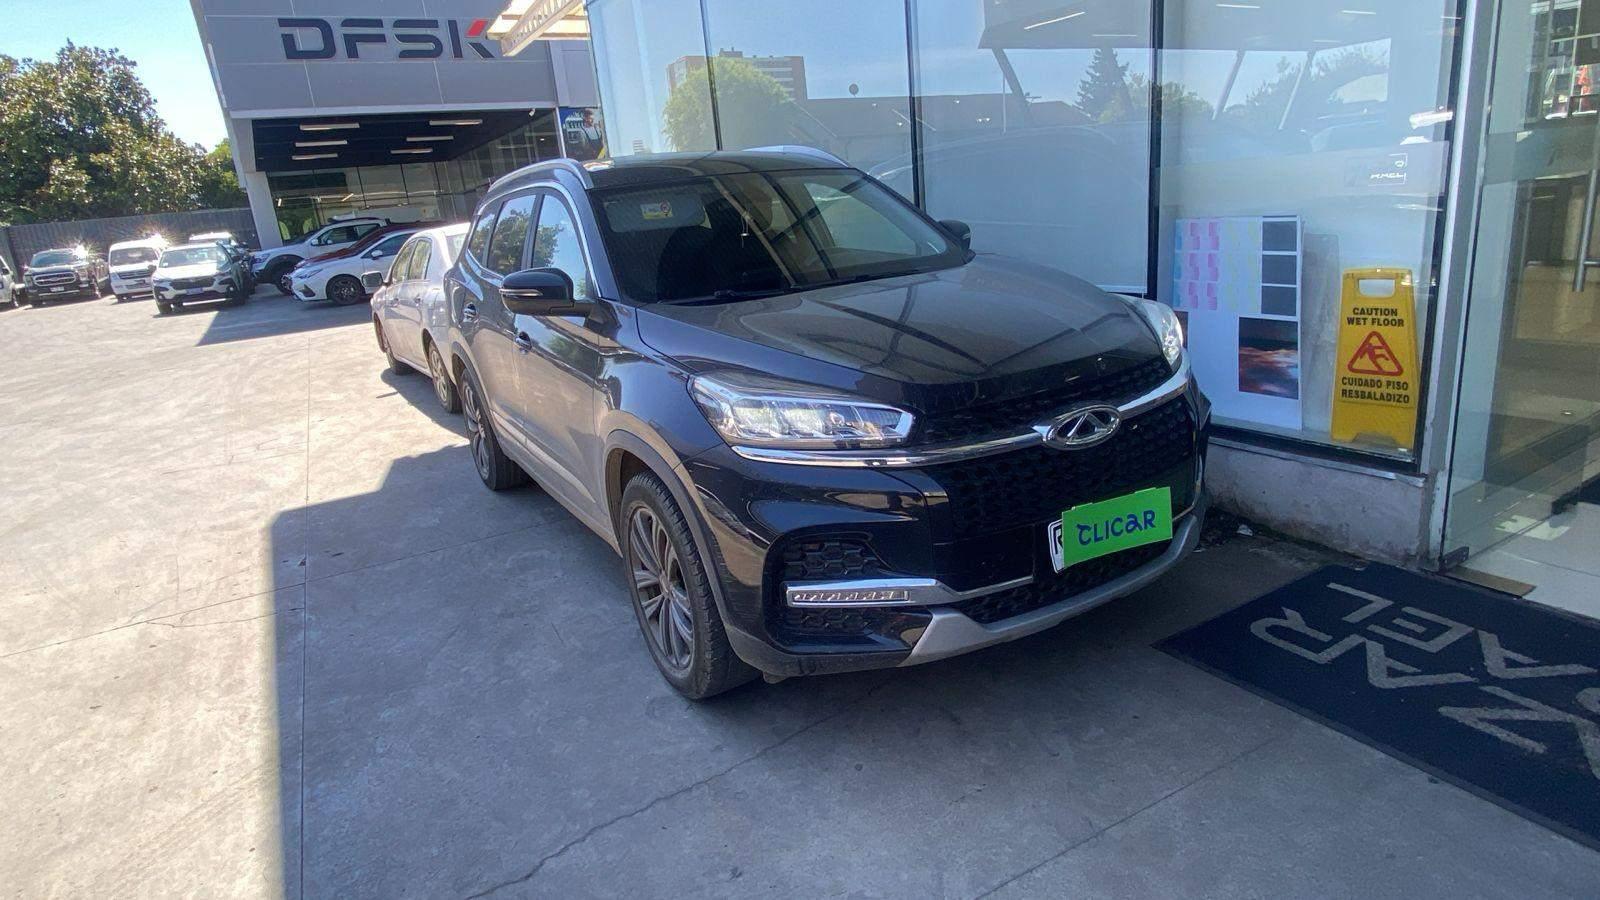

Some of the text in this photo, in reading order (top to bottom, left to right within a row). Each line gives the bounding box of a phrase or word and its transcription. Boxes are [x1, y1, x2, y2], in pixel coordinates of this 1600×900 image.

[277, 18, 495, 60] DFSK
[1352, 307, 1398, 317] CAUTION
[1347, 317, 1404, 327] WET FLOOR
[1341, 377, 1409, 391] CUIDADO PISO
[1341, 389, 1410, 404] RESBALADIZO
